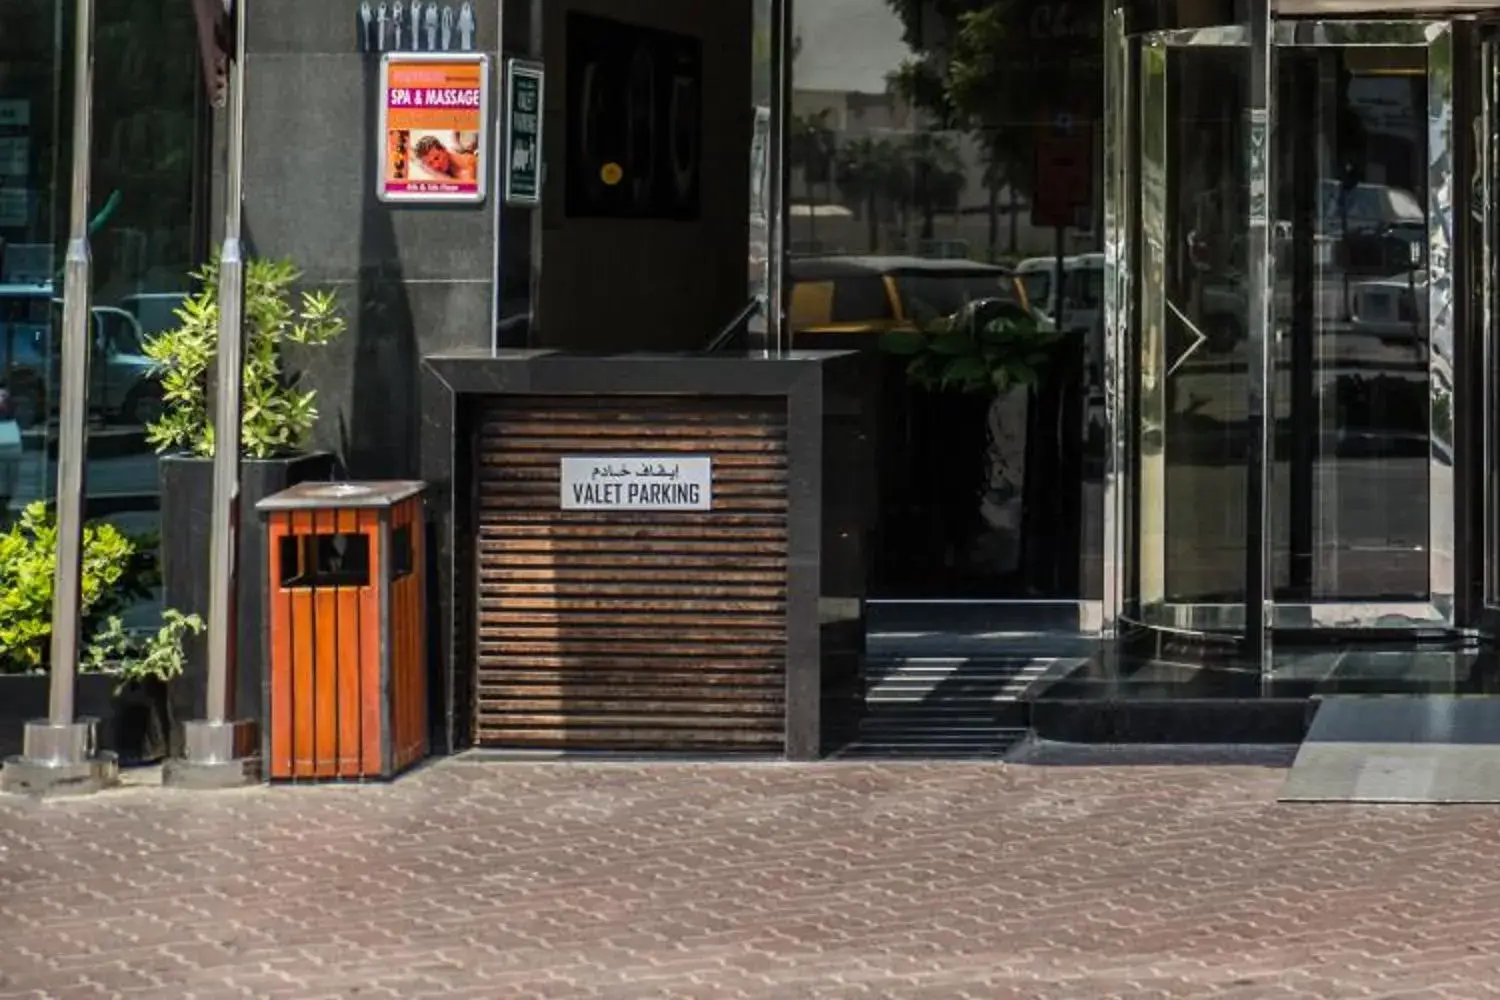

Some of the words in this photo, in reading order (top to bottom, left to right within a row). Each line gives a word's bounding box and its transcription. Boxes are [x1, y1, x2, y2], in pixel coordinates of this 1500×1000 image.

[391, 89, 411, 105] SPA
[414, 89, 424, 105] &
[426, 88, 480, 106] MASSAGE
[573, 483, 622, 505] VALET
[628, 483, 700, 505] PARKING
